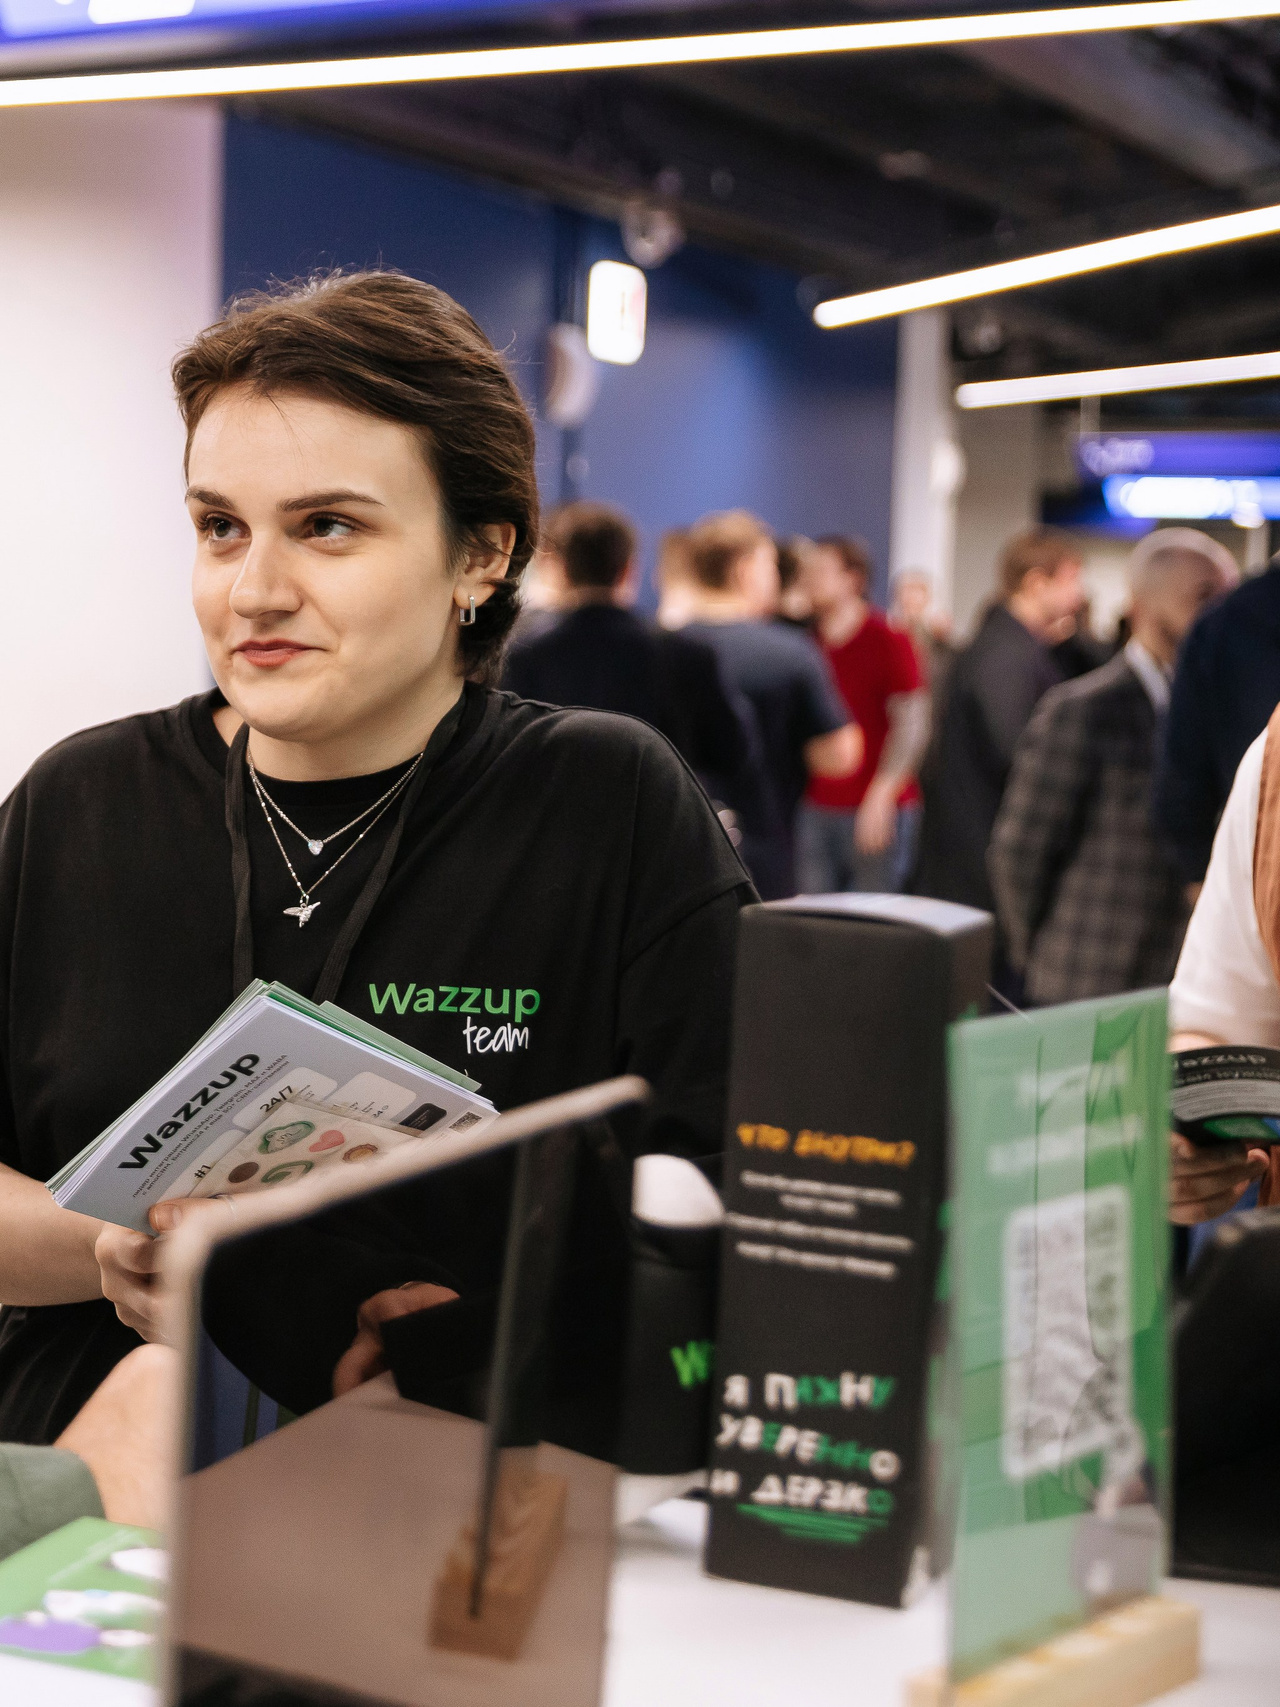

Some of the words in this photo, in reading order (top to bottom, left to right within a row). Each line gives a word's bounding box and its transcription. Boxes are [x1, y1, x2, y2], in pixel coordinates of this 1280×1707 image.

[369, 983, 540, 1022] Wazzup
[463, 1016, 529, 1054] team
[117, 1054, 260, 1168] Wazzup
[260, 1085, 293, 1112] 24/7
[194, 1164, 211, 1179] #1
